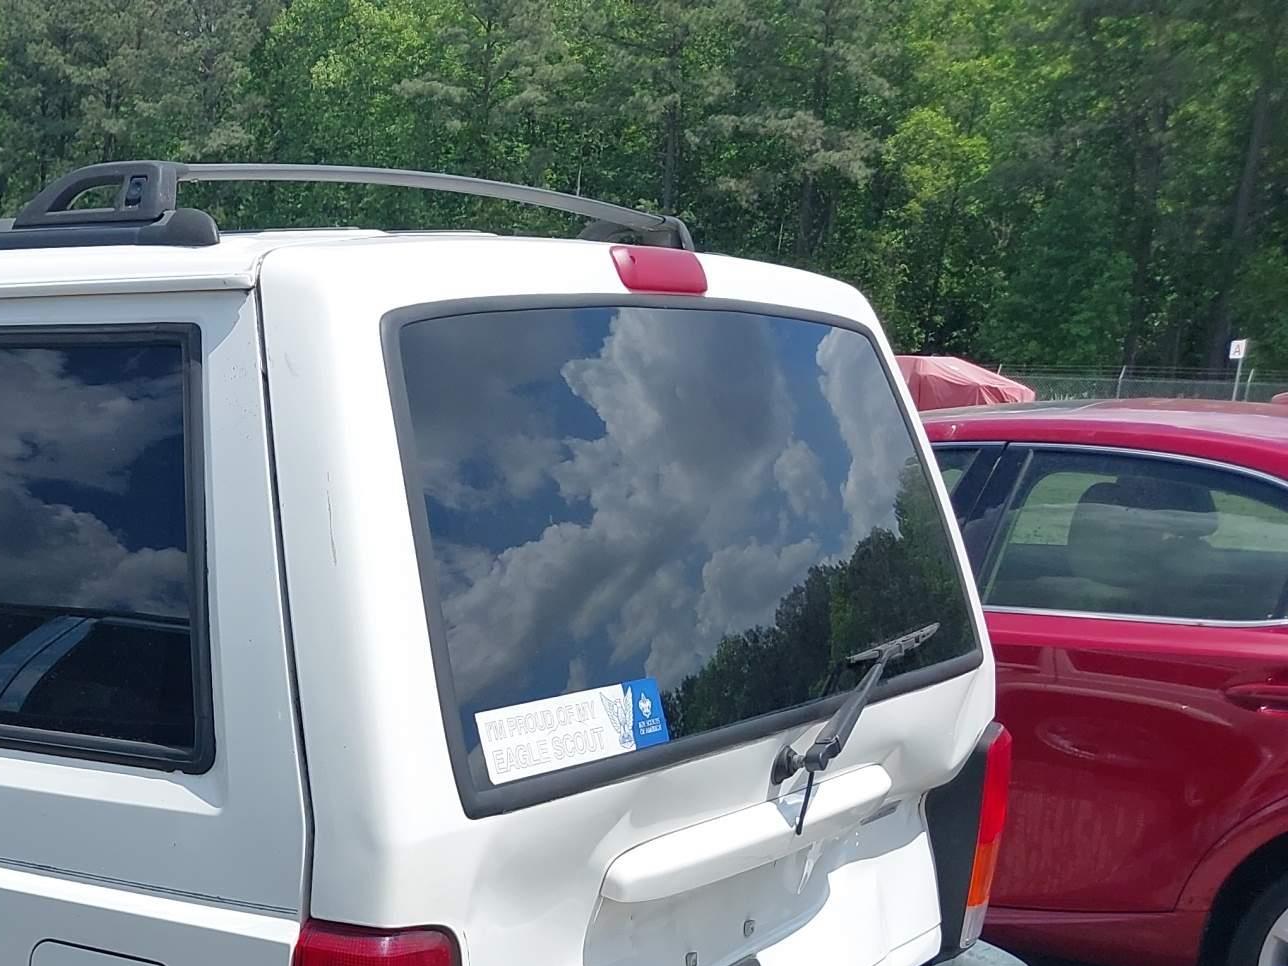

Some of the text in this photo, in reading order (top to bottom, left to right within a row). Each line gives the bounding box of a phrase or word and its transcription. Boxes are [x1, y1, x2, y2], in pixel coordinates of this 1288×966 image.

[484, 700, 597, 742] I'M PROUD OF MY
[492, 726, 605, 774] EAGLE SCOUT
